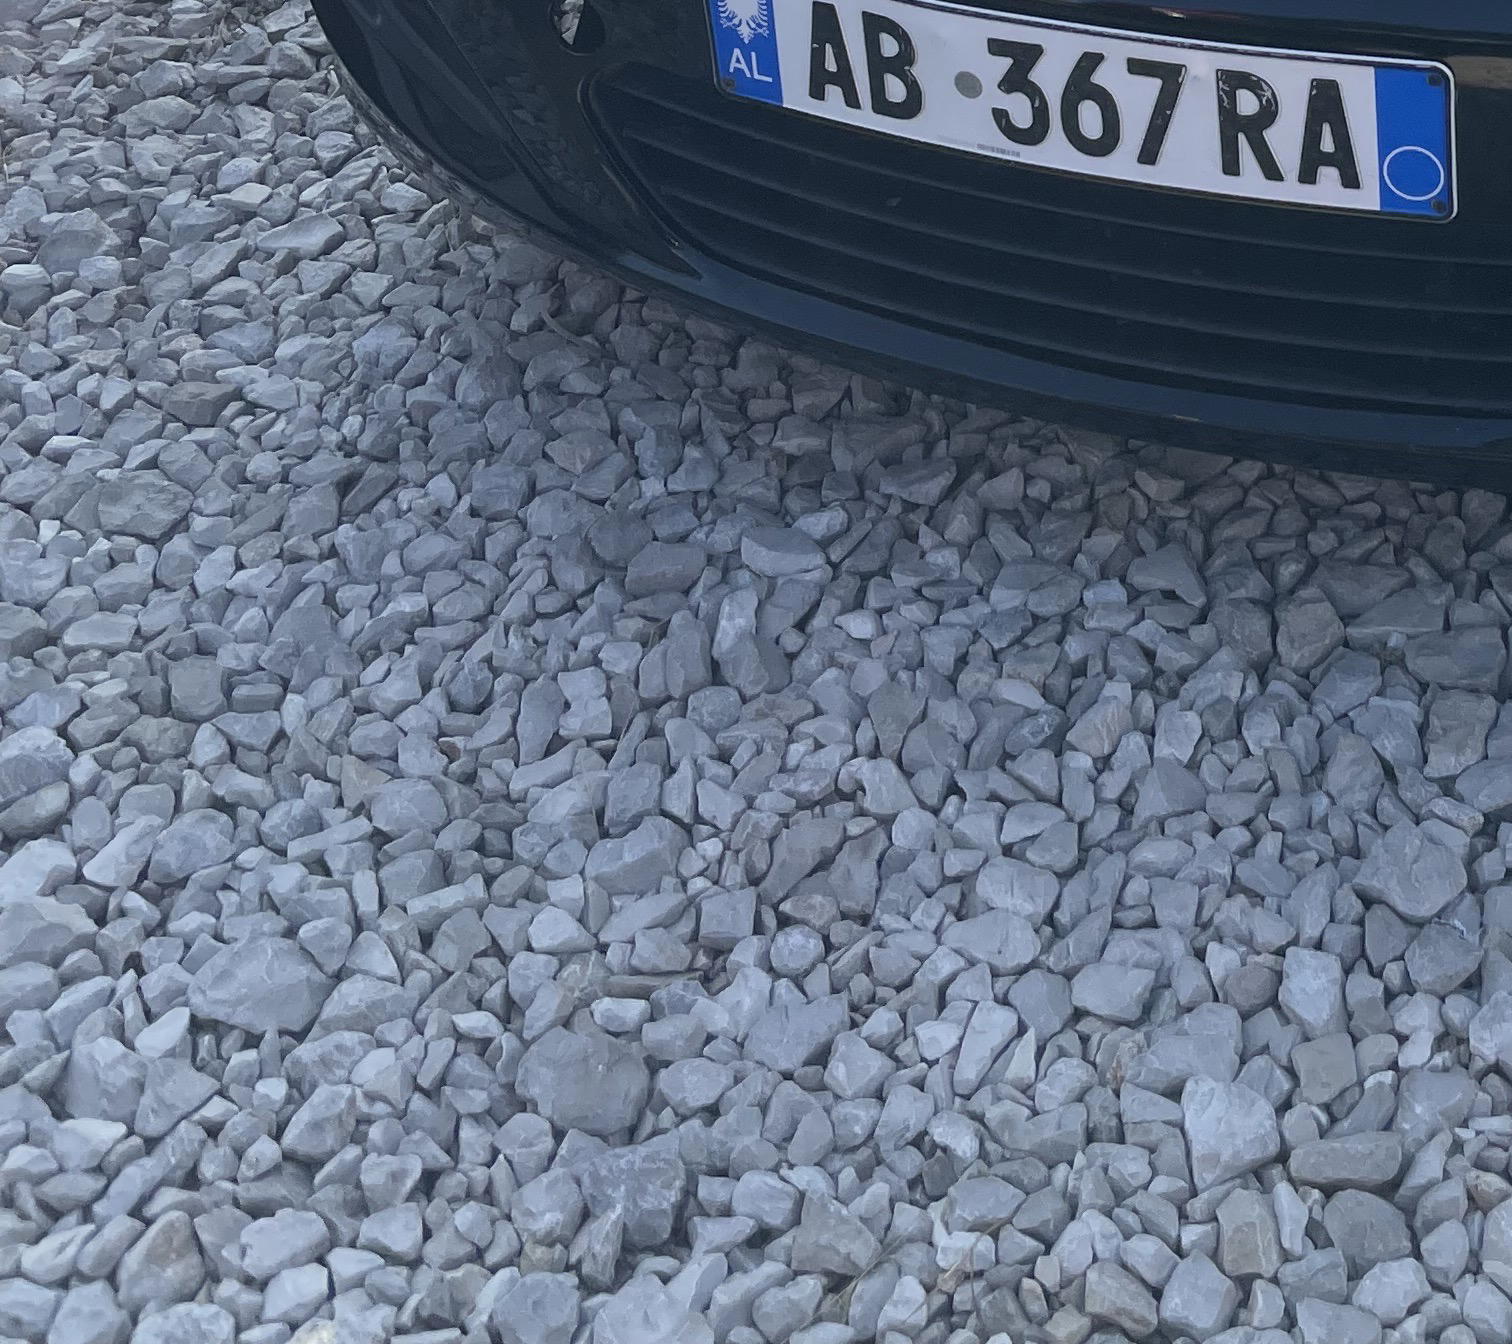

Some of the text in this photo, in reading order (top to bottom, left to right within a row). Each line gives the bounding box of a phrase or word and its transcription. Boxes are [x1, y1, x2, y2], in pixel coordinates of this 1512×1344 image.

[728, 47, 774, 83] AL
[808, 0, 1362, 190] AB 367 RA
